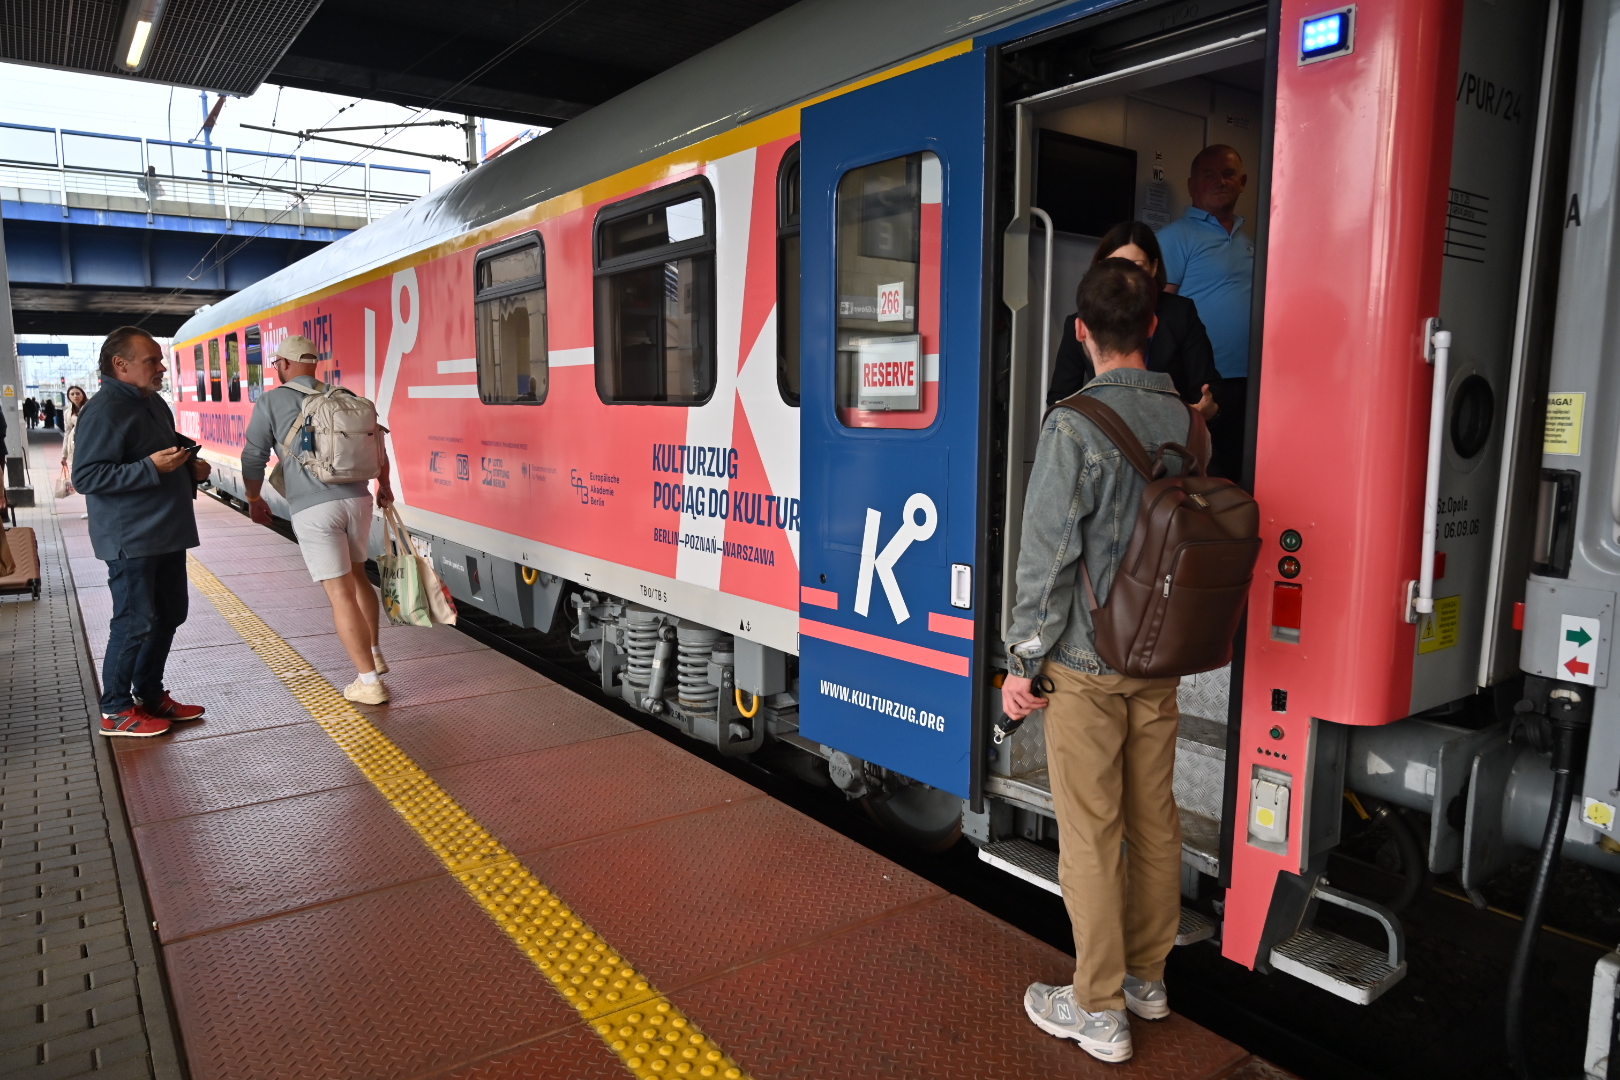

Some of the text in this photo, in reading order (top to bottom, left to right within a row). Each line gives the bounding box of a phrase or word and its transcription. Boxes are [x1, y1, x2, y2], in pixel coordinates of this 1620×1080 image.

[1565, 193, 1582, 229] A
[881, 290, 900, 315] 266
[863, 361, 915, 387] RESERVE
[653, 443, 738, 480] KULTURZUG
[493, 478, 506, 488] BERLIN
[590, 472, 620, 485] Europäische
[590, 485, 615, 497] Akademie
[590, 497, 605, 508] Berlin
[653, 481, 706, 520] POCIĄG
[708, 487, 730, 520] DO
[1444, 518, 1480, 539] 06.09.06
[820, 679, 945, 732] WWW.KULTURZUG.ORG
